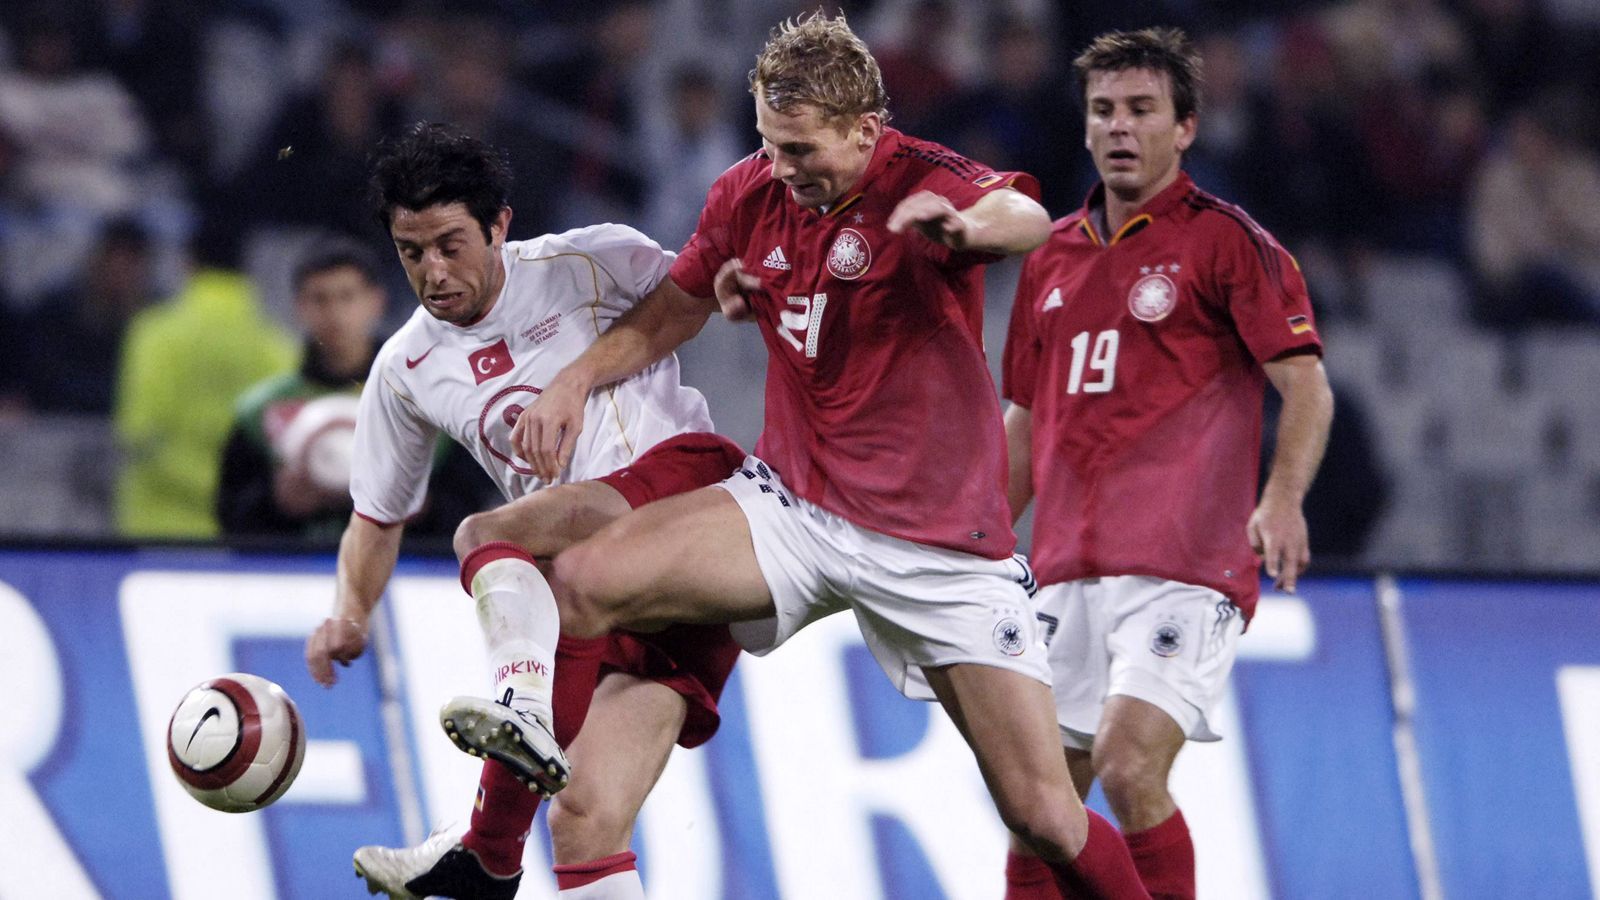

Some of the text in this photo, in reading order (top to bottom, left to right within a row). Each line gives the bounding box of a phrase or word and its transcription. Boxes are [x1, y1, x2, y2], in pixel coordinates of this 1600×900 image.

[763, 259, 791, 270] adidas
[777, 293, 828, 357] 21
[1066, 329, 1119, 394] 19
